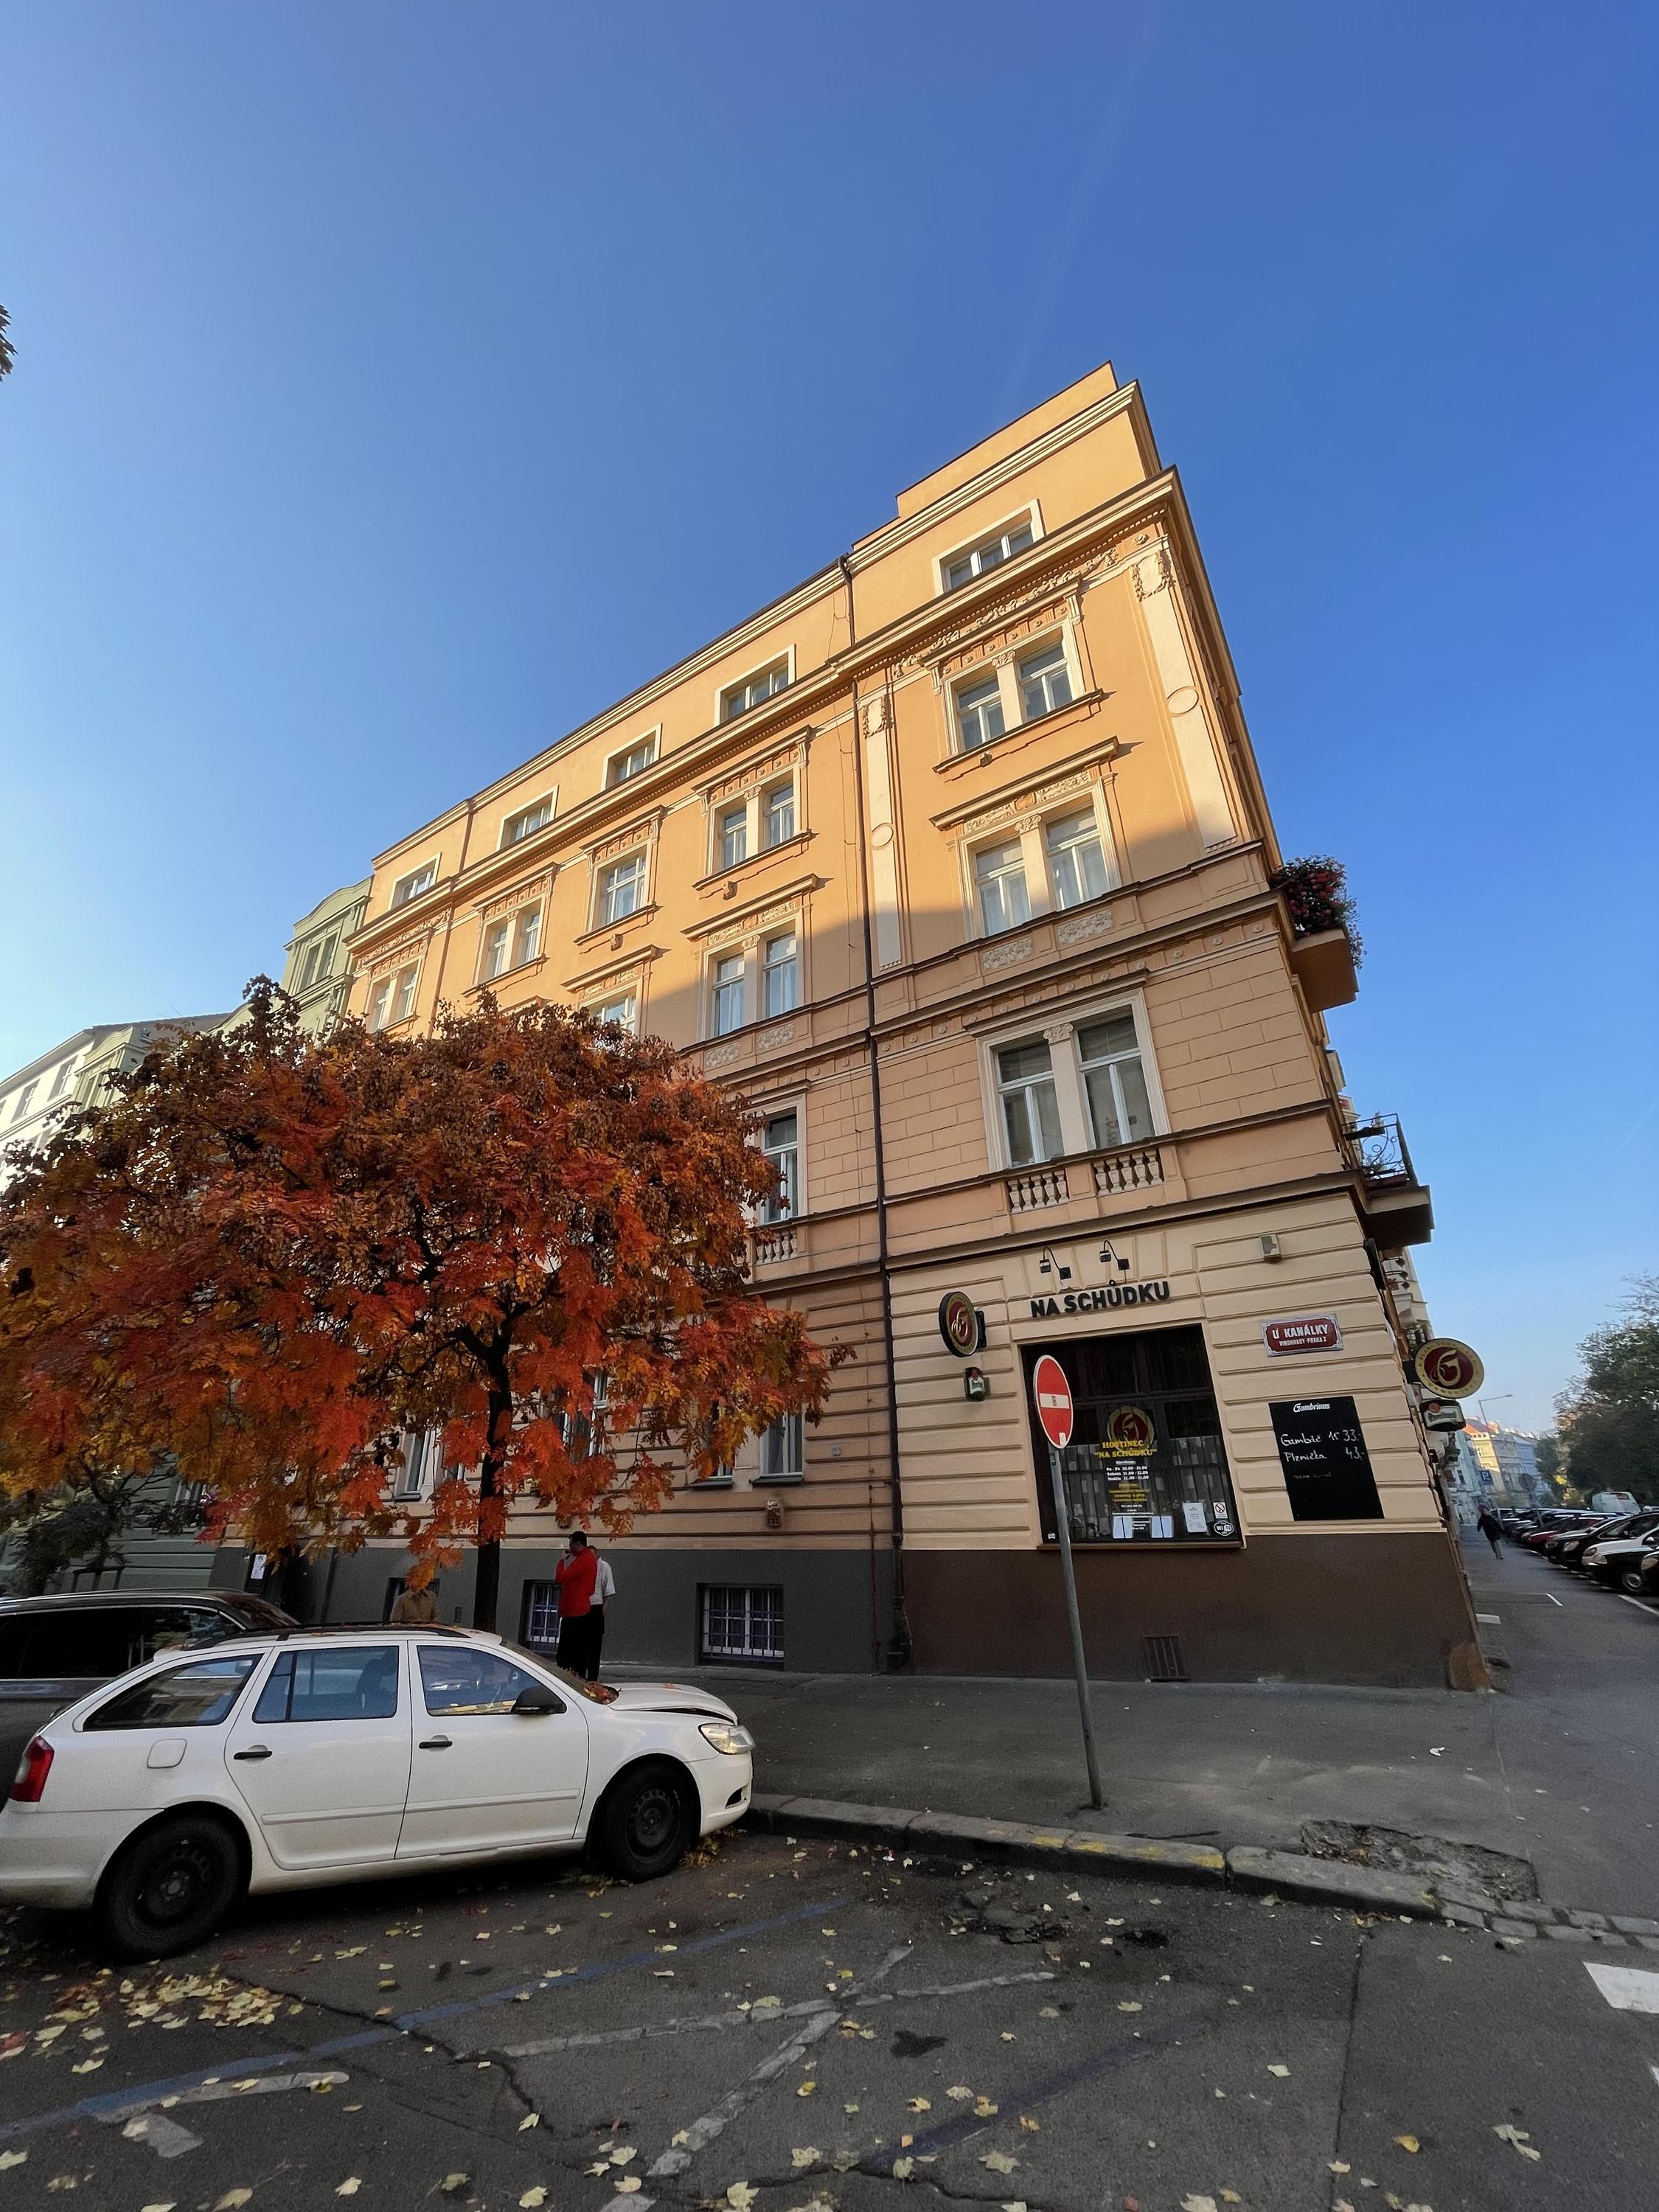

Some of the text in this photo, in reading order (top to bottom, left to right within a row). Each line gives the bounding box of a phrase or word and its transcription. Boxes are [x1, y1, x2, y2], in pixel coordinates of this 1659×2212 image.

[1030, 1279, 1170, 1318] NA SCHŮDKU
[1284, 1324, 1328, 1338] KANÁLKY
[1293, 1402, 1331, 1413] Gambrinus
[1102, 1440, 1144, 1449] HOSTINEC
